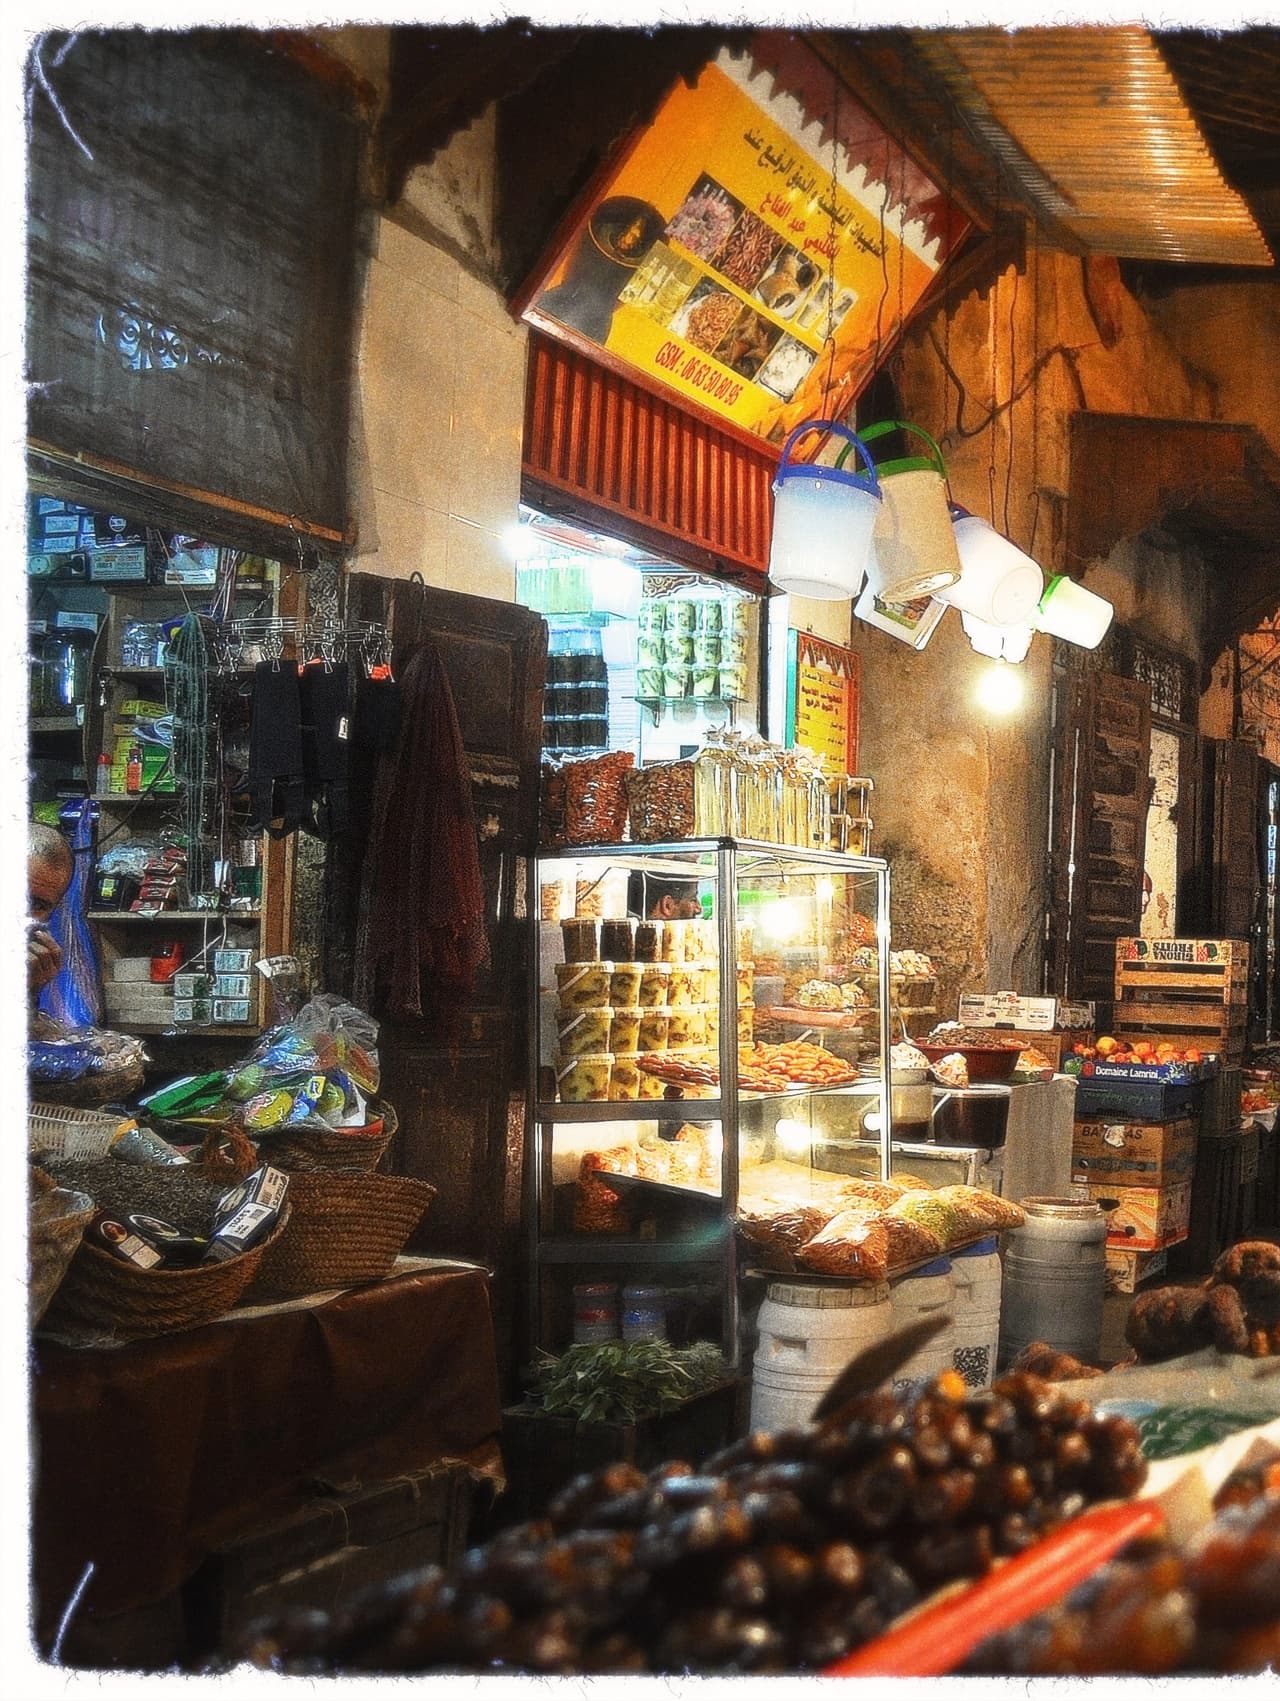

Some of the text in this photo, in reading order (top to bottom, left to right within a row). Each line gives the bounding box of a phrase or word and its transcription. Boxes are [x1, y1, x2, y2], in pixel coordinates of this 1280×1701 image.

[743, 128, 763, 150] عند
[757, 147, 796, 176] الرفيع
[655, 341, 685, 371] GSM
[681, 356, 701, 380] 06
[692, 363, 711, 387] 63
[703, 370, 722, 393] 50
[724, 383, 744, 406] 95
[1153, 942, 1194, 953] FRUITS
[1153, 950, 1195, 962] GIRONA
[1095, 1065, 1159, 1079] Domaine Lamrini
[1081, 1126, 1143, 1139] BAAS
